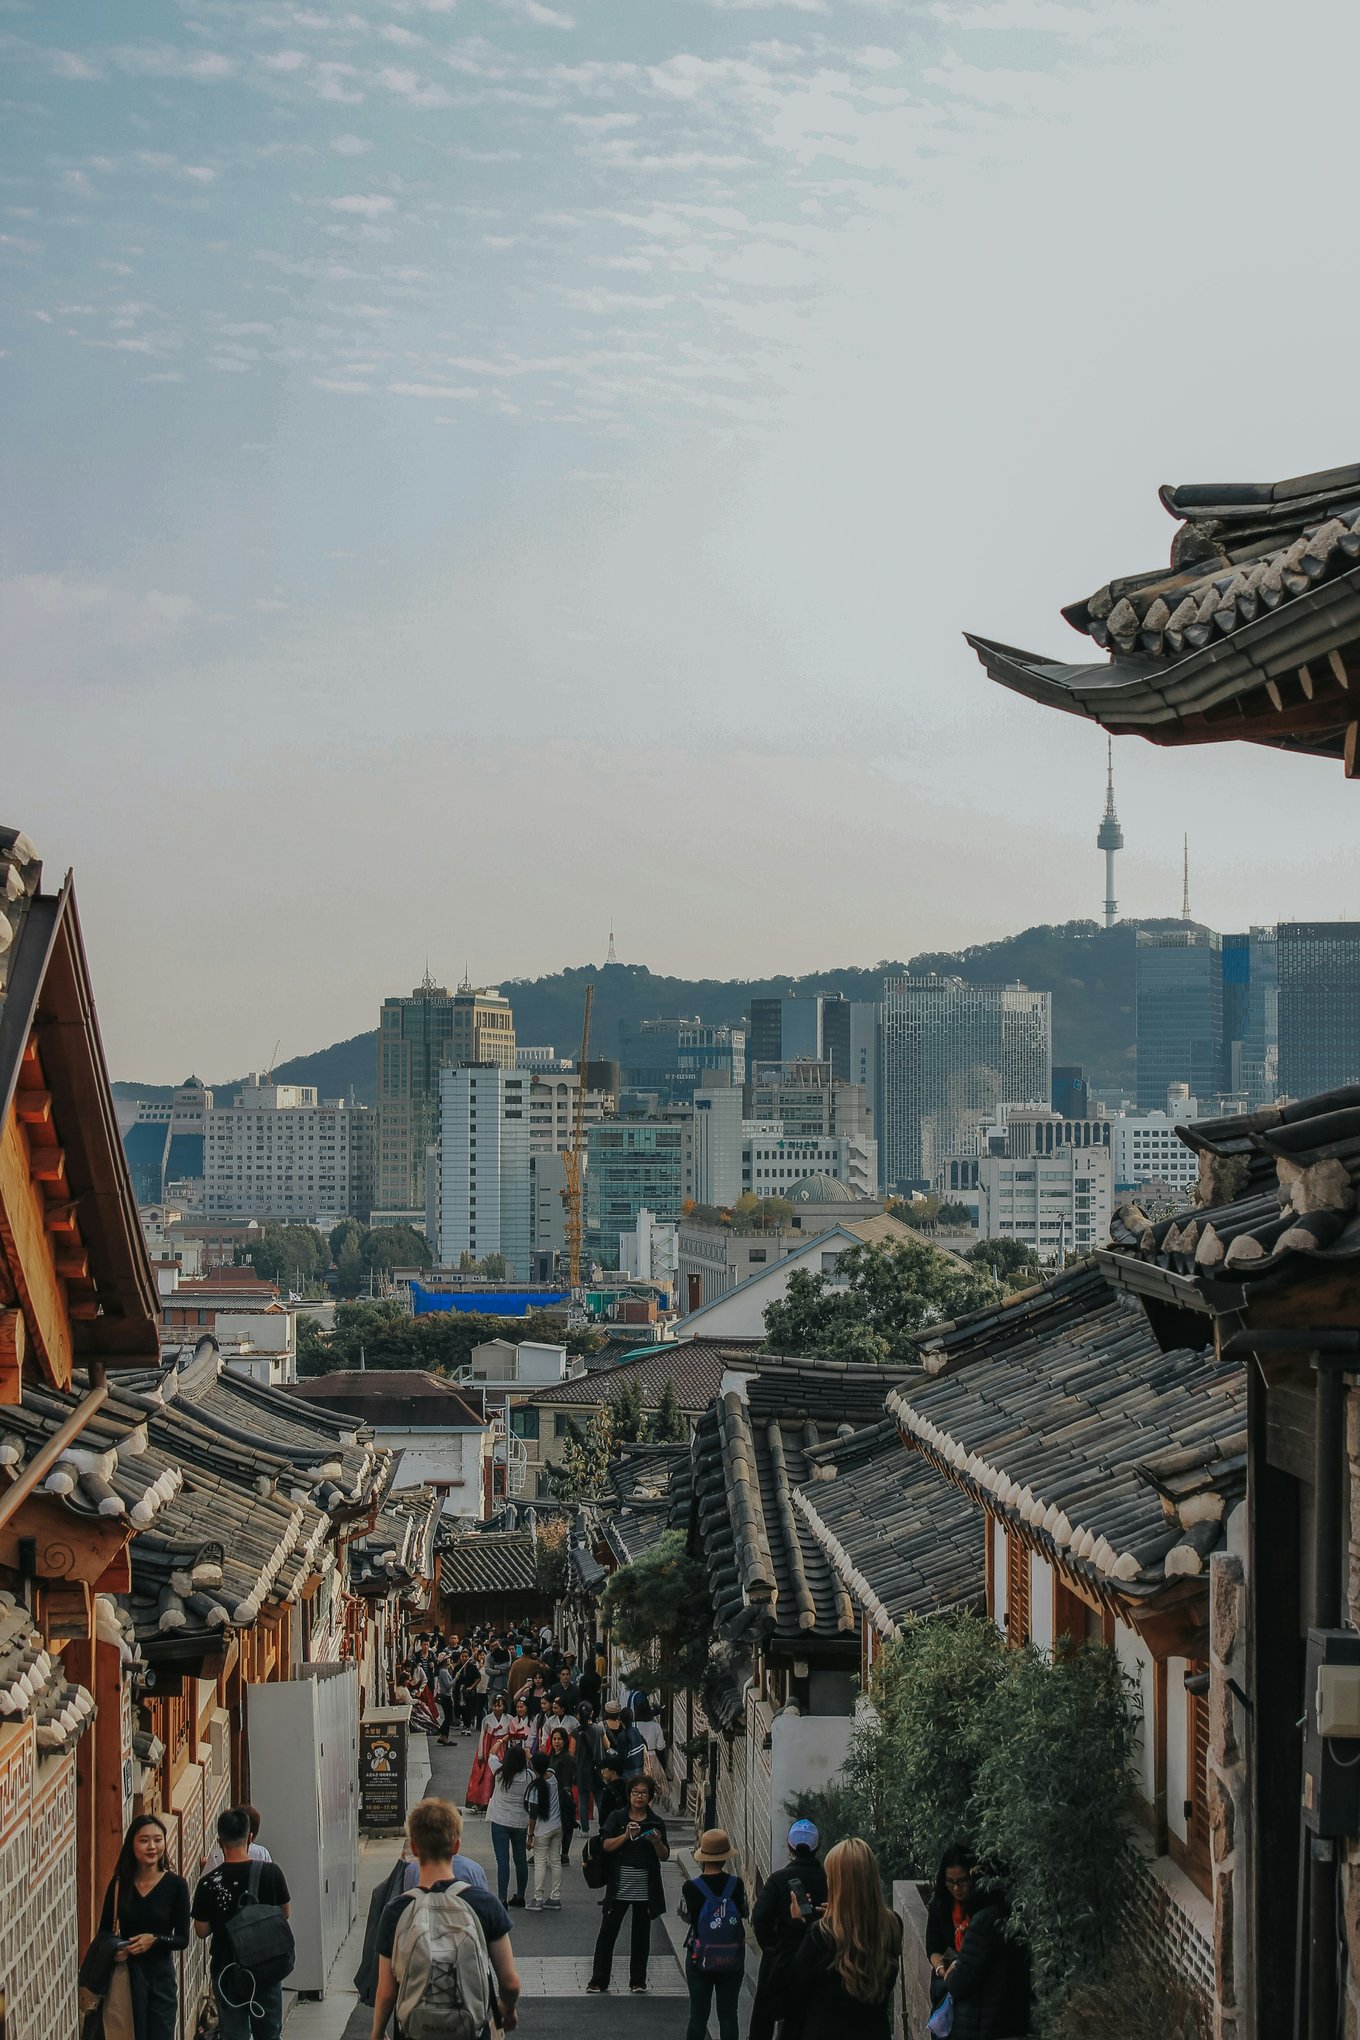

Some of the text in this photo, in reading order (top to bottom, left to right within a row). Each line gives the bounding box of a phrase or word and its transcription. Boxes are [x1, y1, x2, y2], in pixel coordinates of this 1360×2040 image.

[907, 985, 946, 993] Hanwha
[430, 998, 456, 1006] SUITES
[788, 1140, 819, 1150] 하나은행
